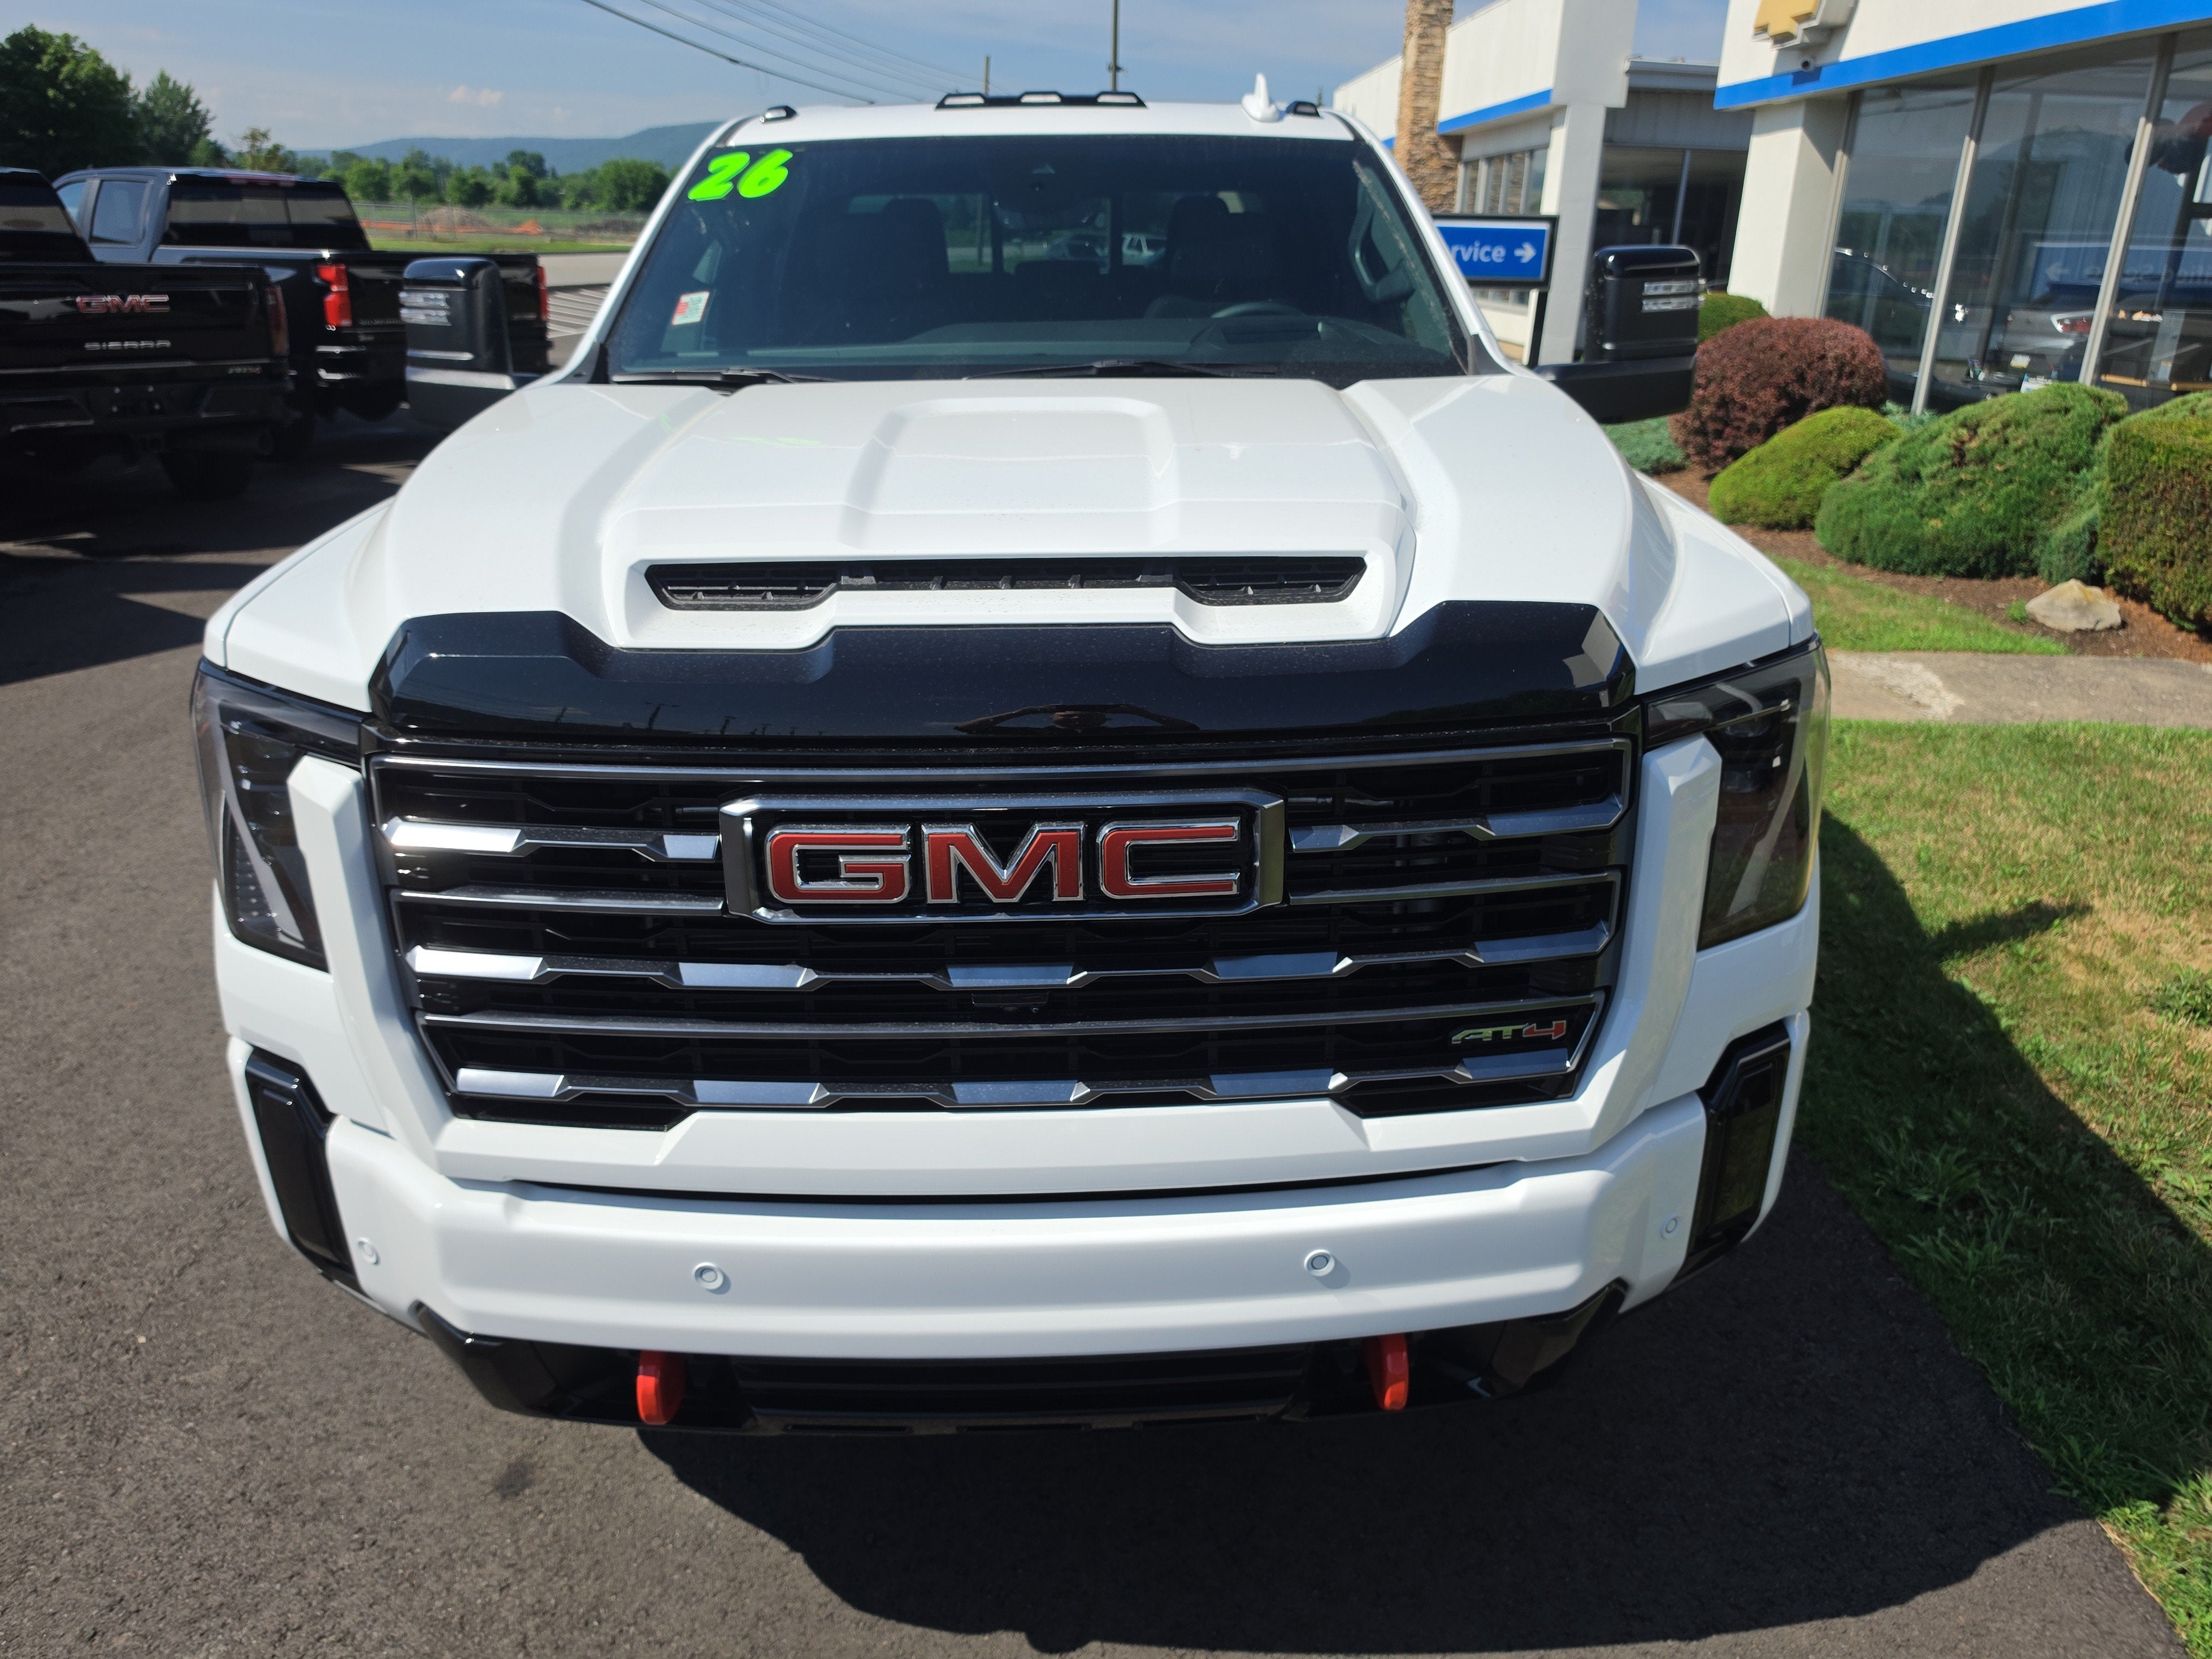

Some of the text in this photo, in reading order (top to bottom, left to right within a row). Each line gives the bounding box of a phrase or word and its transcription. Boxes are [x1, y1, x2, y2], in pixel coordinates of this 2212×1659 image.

[687, 149, 793, 201] 26
[1451, 240, 1506, 263] rvice
[76, 294, 170, 313] GMC
[765, 815, 1241, 904] GMC
[1451, 1020, 1566, 1044] AT4
